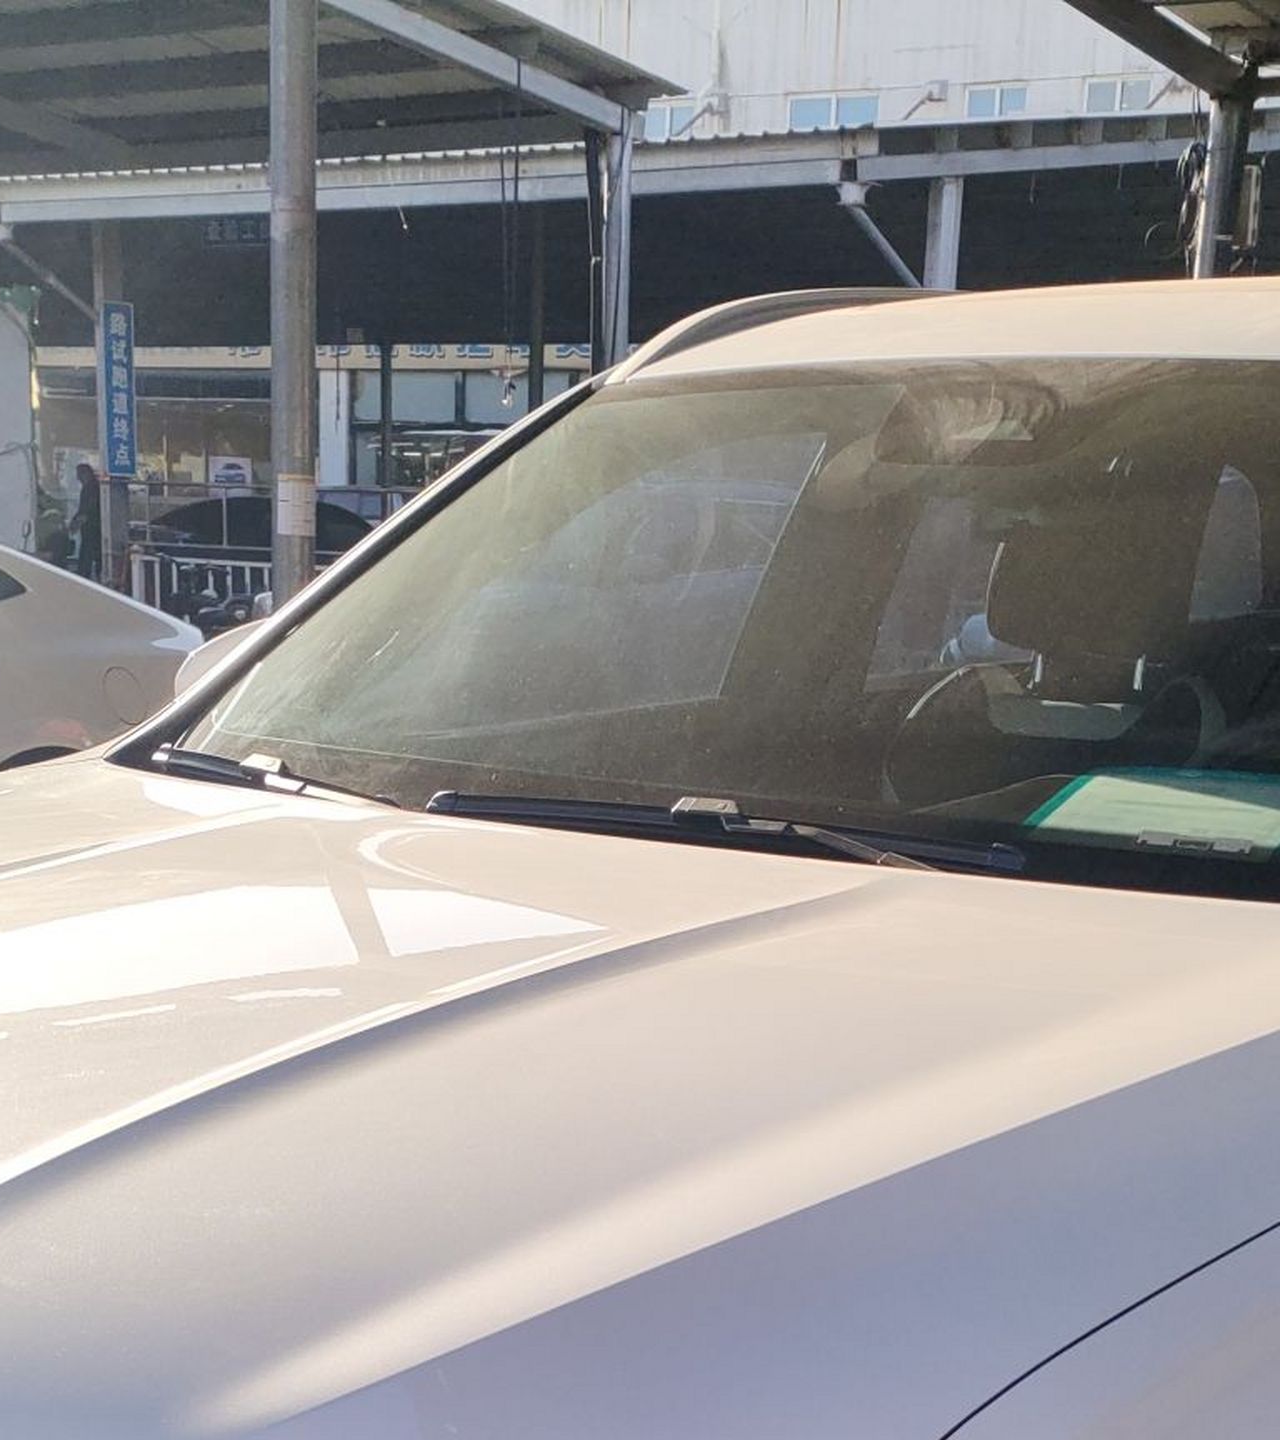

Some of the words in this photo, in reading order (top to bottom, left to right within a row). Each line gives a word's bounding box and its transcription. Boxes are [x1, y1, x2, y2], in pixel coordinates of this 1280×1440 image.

[110, 312, 131, 466] 路试跑道终点
